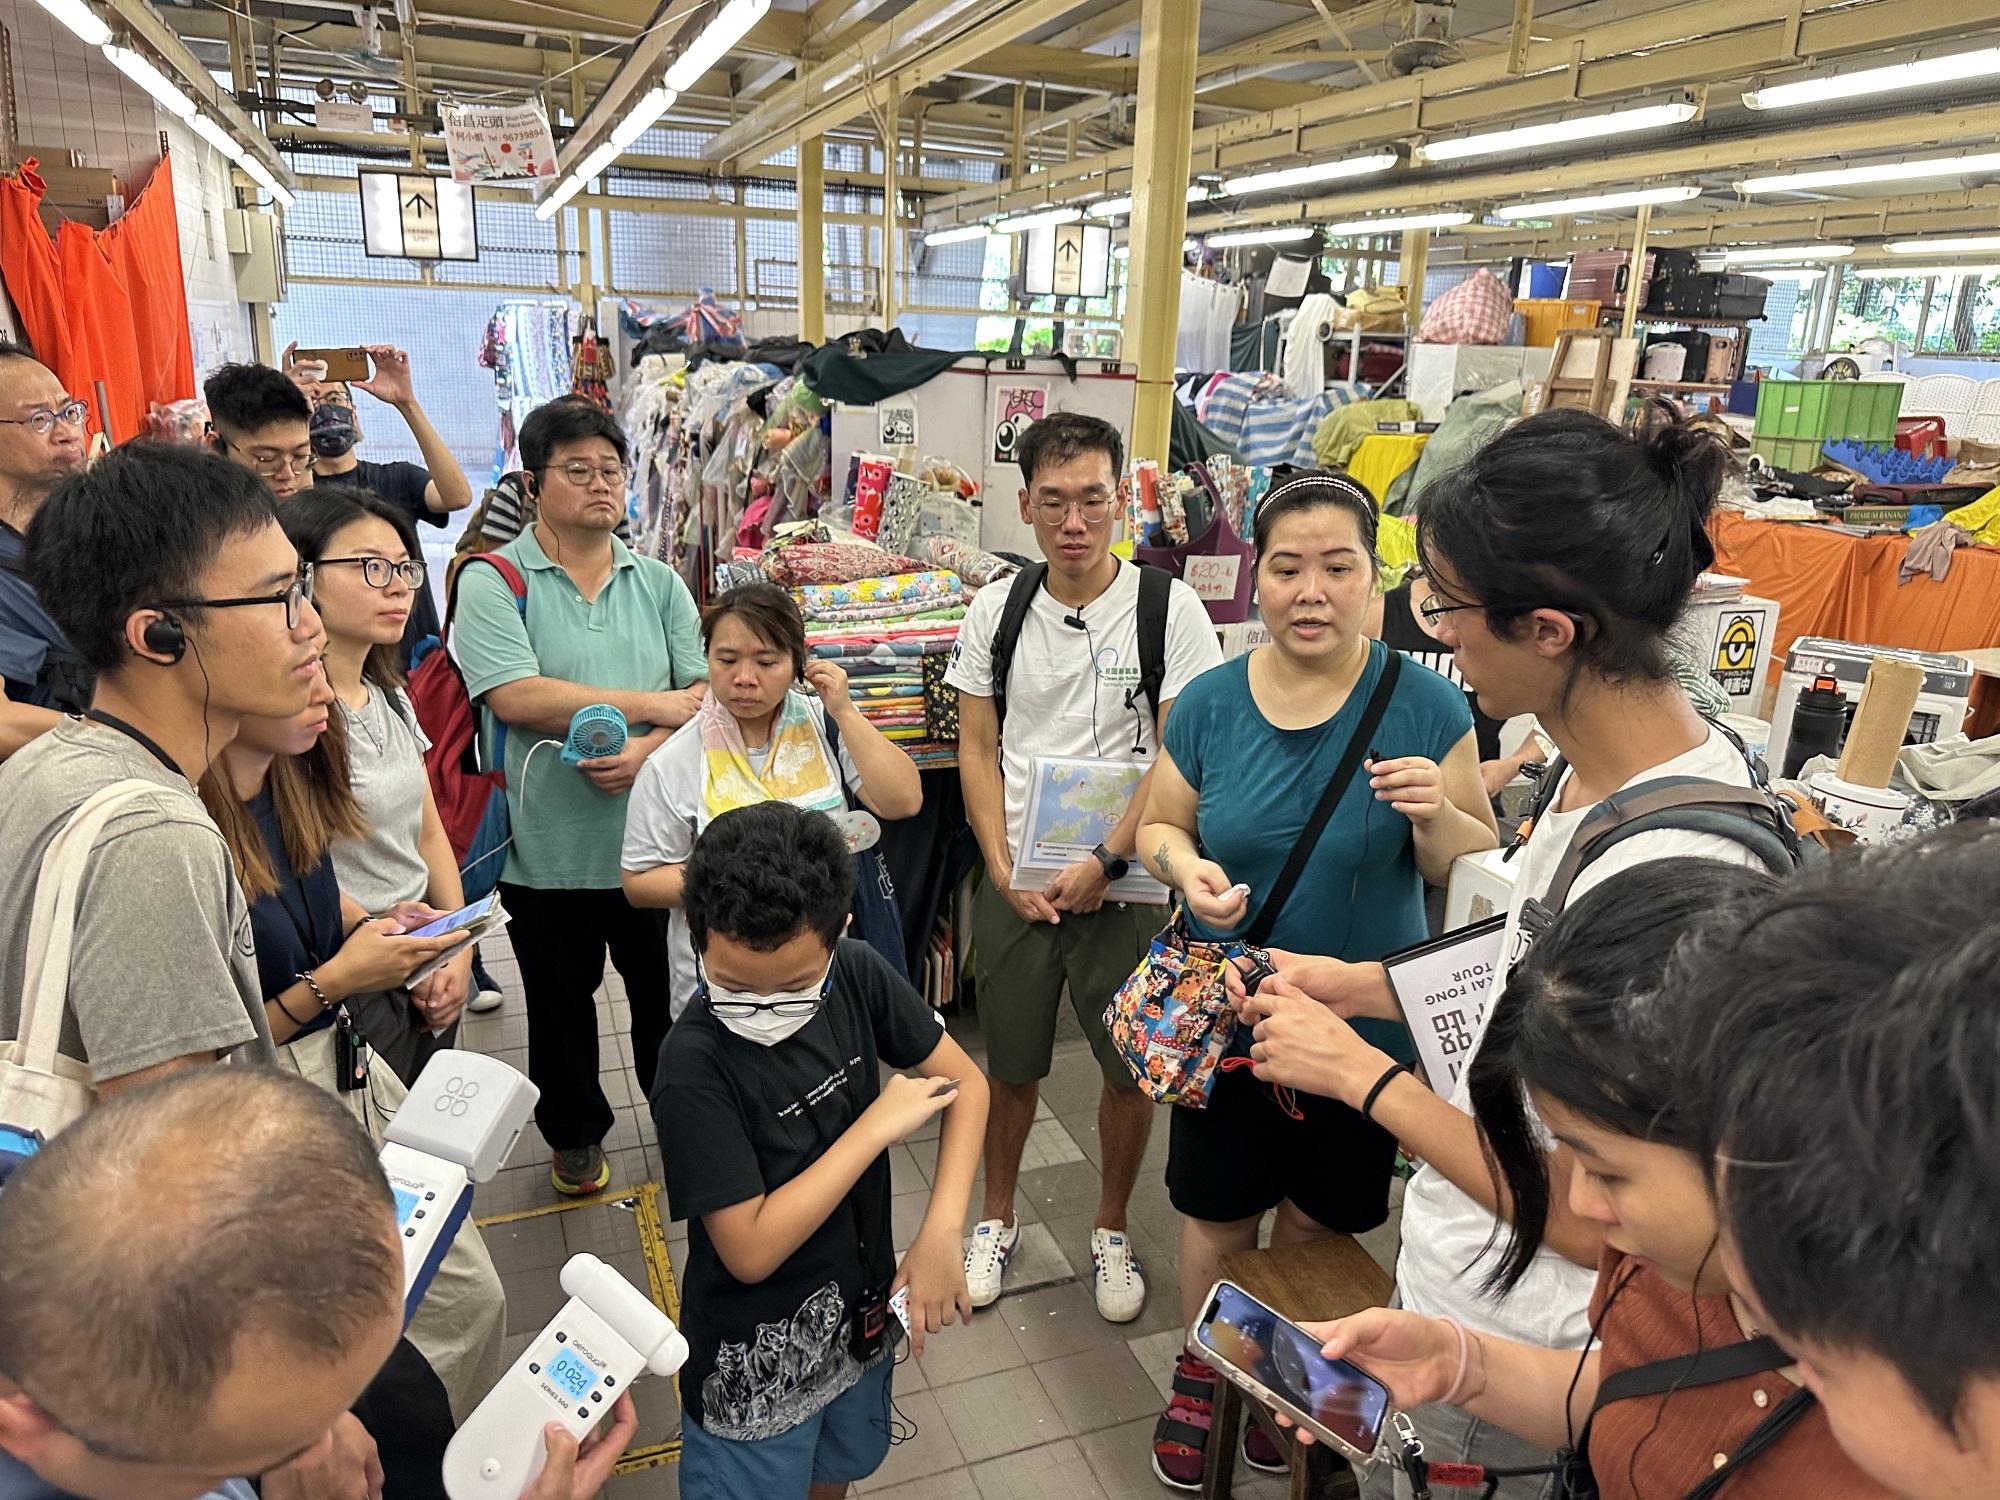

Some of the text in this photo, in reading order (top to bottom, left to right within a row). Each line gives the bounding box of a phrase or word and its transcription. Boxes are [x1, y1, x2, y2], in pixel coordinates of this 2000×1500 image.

[502, 128, 544, 141] 96739894
[1850, 511, 1879, 520] PREMIUM
[1452, 962, 1493, 982] TOUR
[1424, 985, 1467, 1006] FONG
[541, 1382, 559, 1400] SERIES
[557, 1397, 569, 1409] 500
